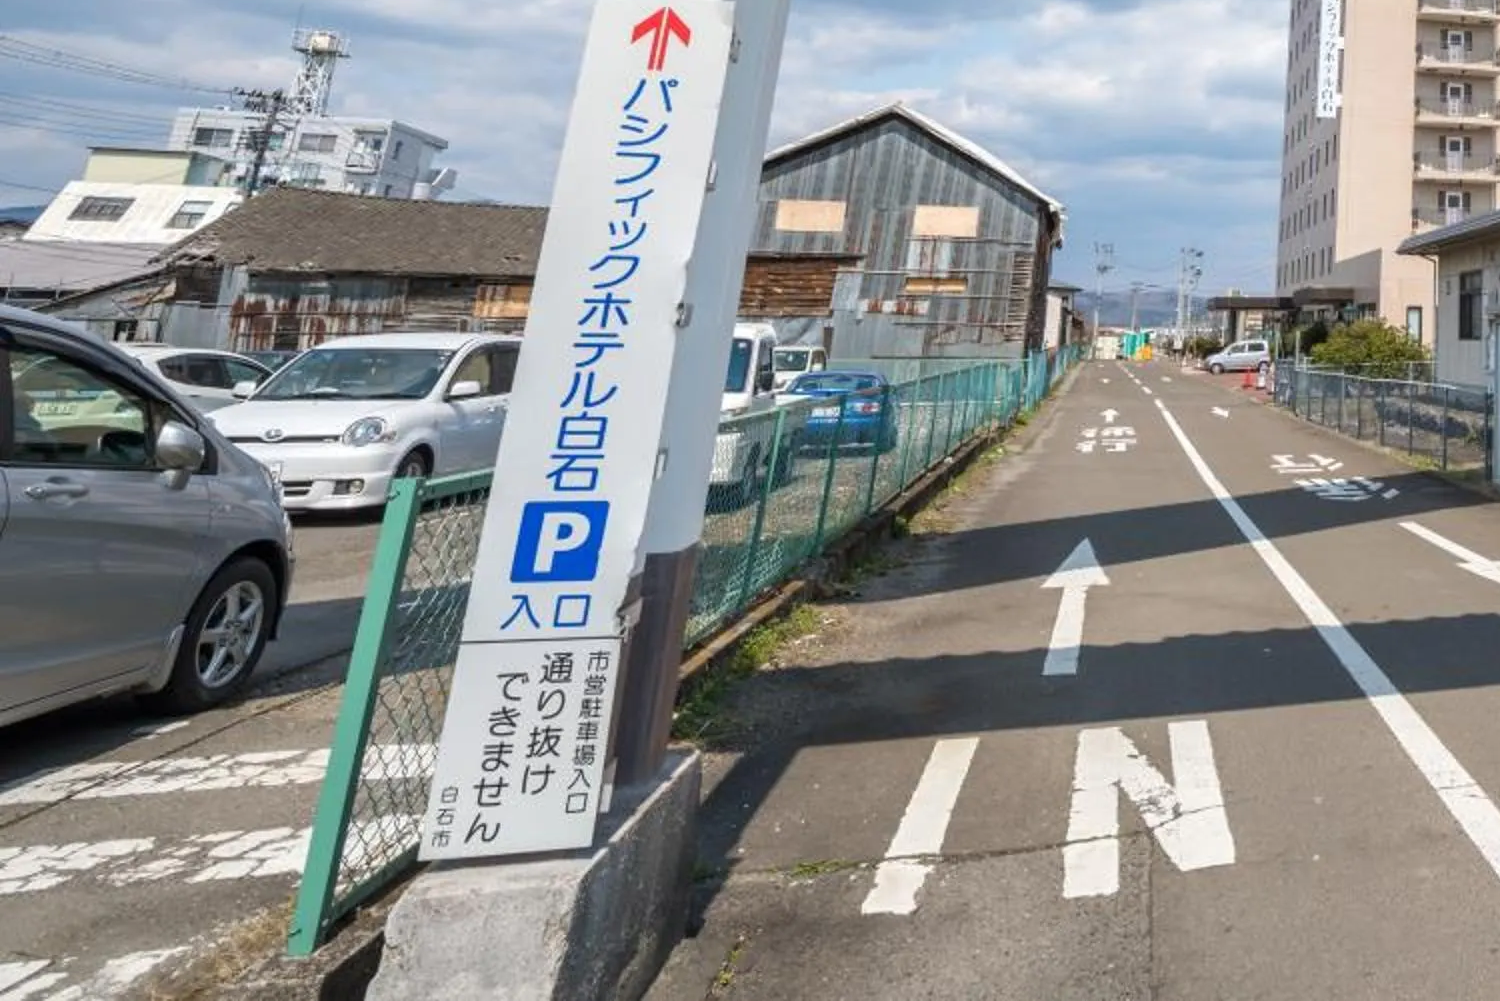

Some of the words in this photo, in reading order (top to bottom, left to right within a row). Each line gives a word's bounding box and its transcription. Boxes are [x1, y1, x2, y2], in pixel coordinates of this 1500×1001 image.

[545, 79, 679, 492] パシフィックホテル白石
[500, 594, 591, 630] 入口
[533, 511, 591, 574] P
[464, 673, 529, 844] できません
[521, 652, 573, 796] 通り抜け
[565, 650, 611, 814] 市営駐車場入口
[431, 785, 459, 848] 白石市
[860, 719, 1236, 916] IN
